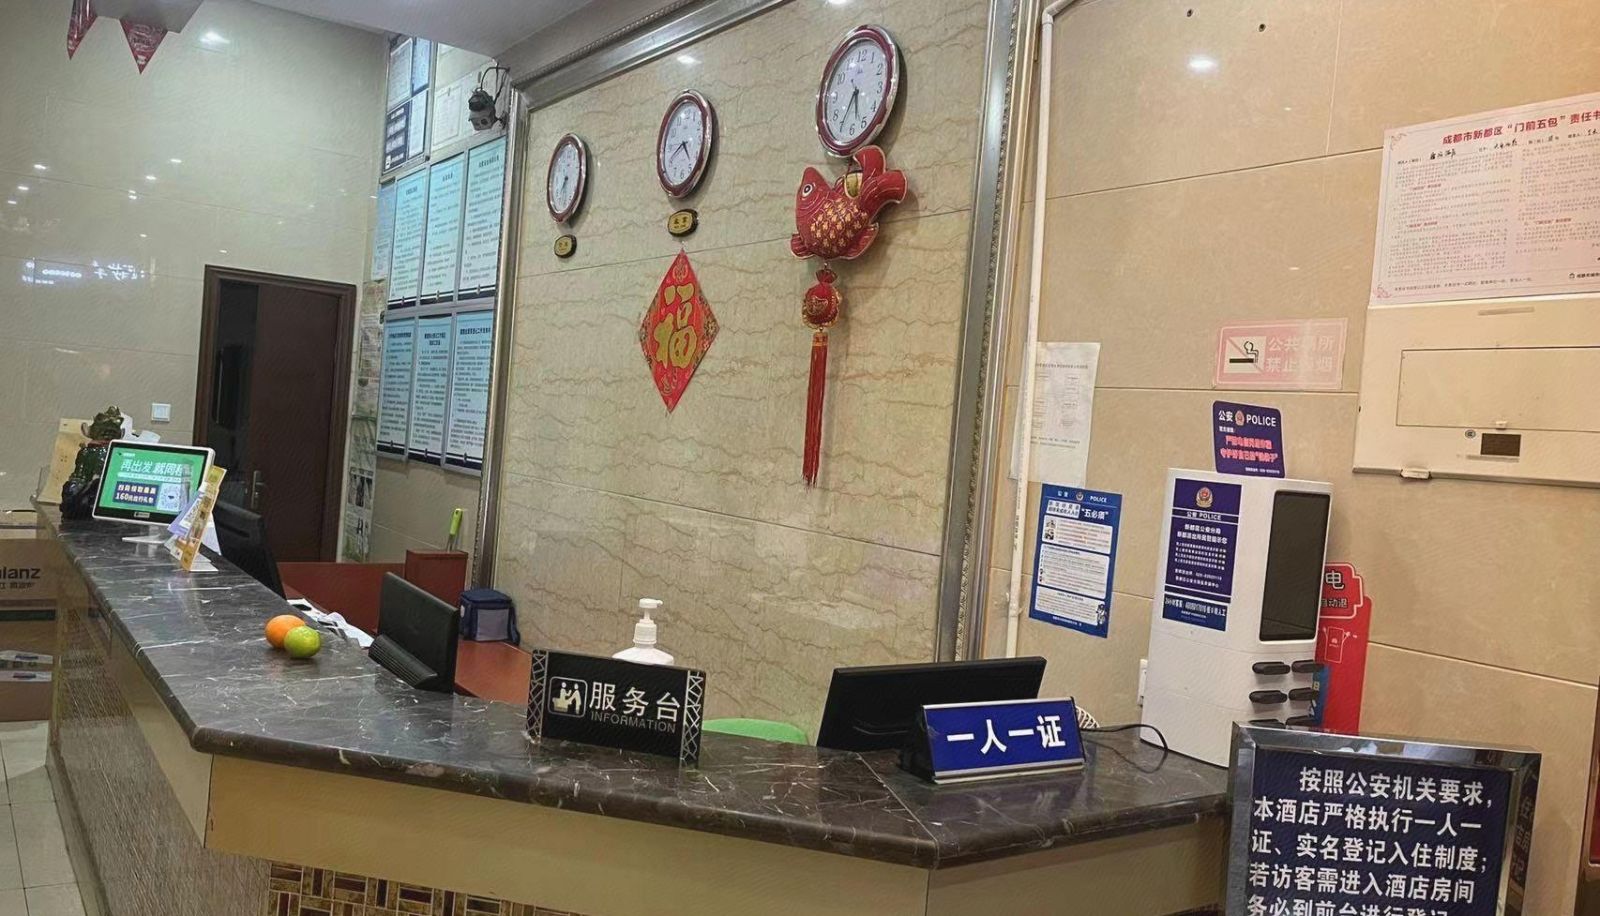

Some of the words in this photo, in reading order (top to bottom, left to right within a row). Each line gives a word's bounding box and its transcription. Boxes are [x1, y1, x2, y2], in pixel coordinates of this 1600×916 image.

[654, 282, 698, 369] 福
[1266, 357, 1333, 373] 禁止烟
[1218, 410, 1234, 422] 公安
[1246, 414, 1276, 427] POLICE
[1200, 512, 1221, 520] POLICE
[0, 566, 41, 579] lanz
[1326, 570, 1344, 590] 电
[589, 682, 681, 722] 服务台
[591, 710, 676, 734] INFORMATION
[946, 715, 1066, 754] 一人一证
[1254, 796, 1482, 838] 本酒店严格执行一人一
[1249, 861, 1475, 904] 若访客需进入酒店房间
